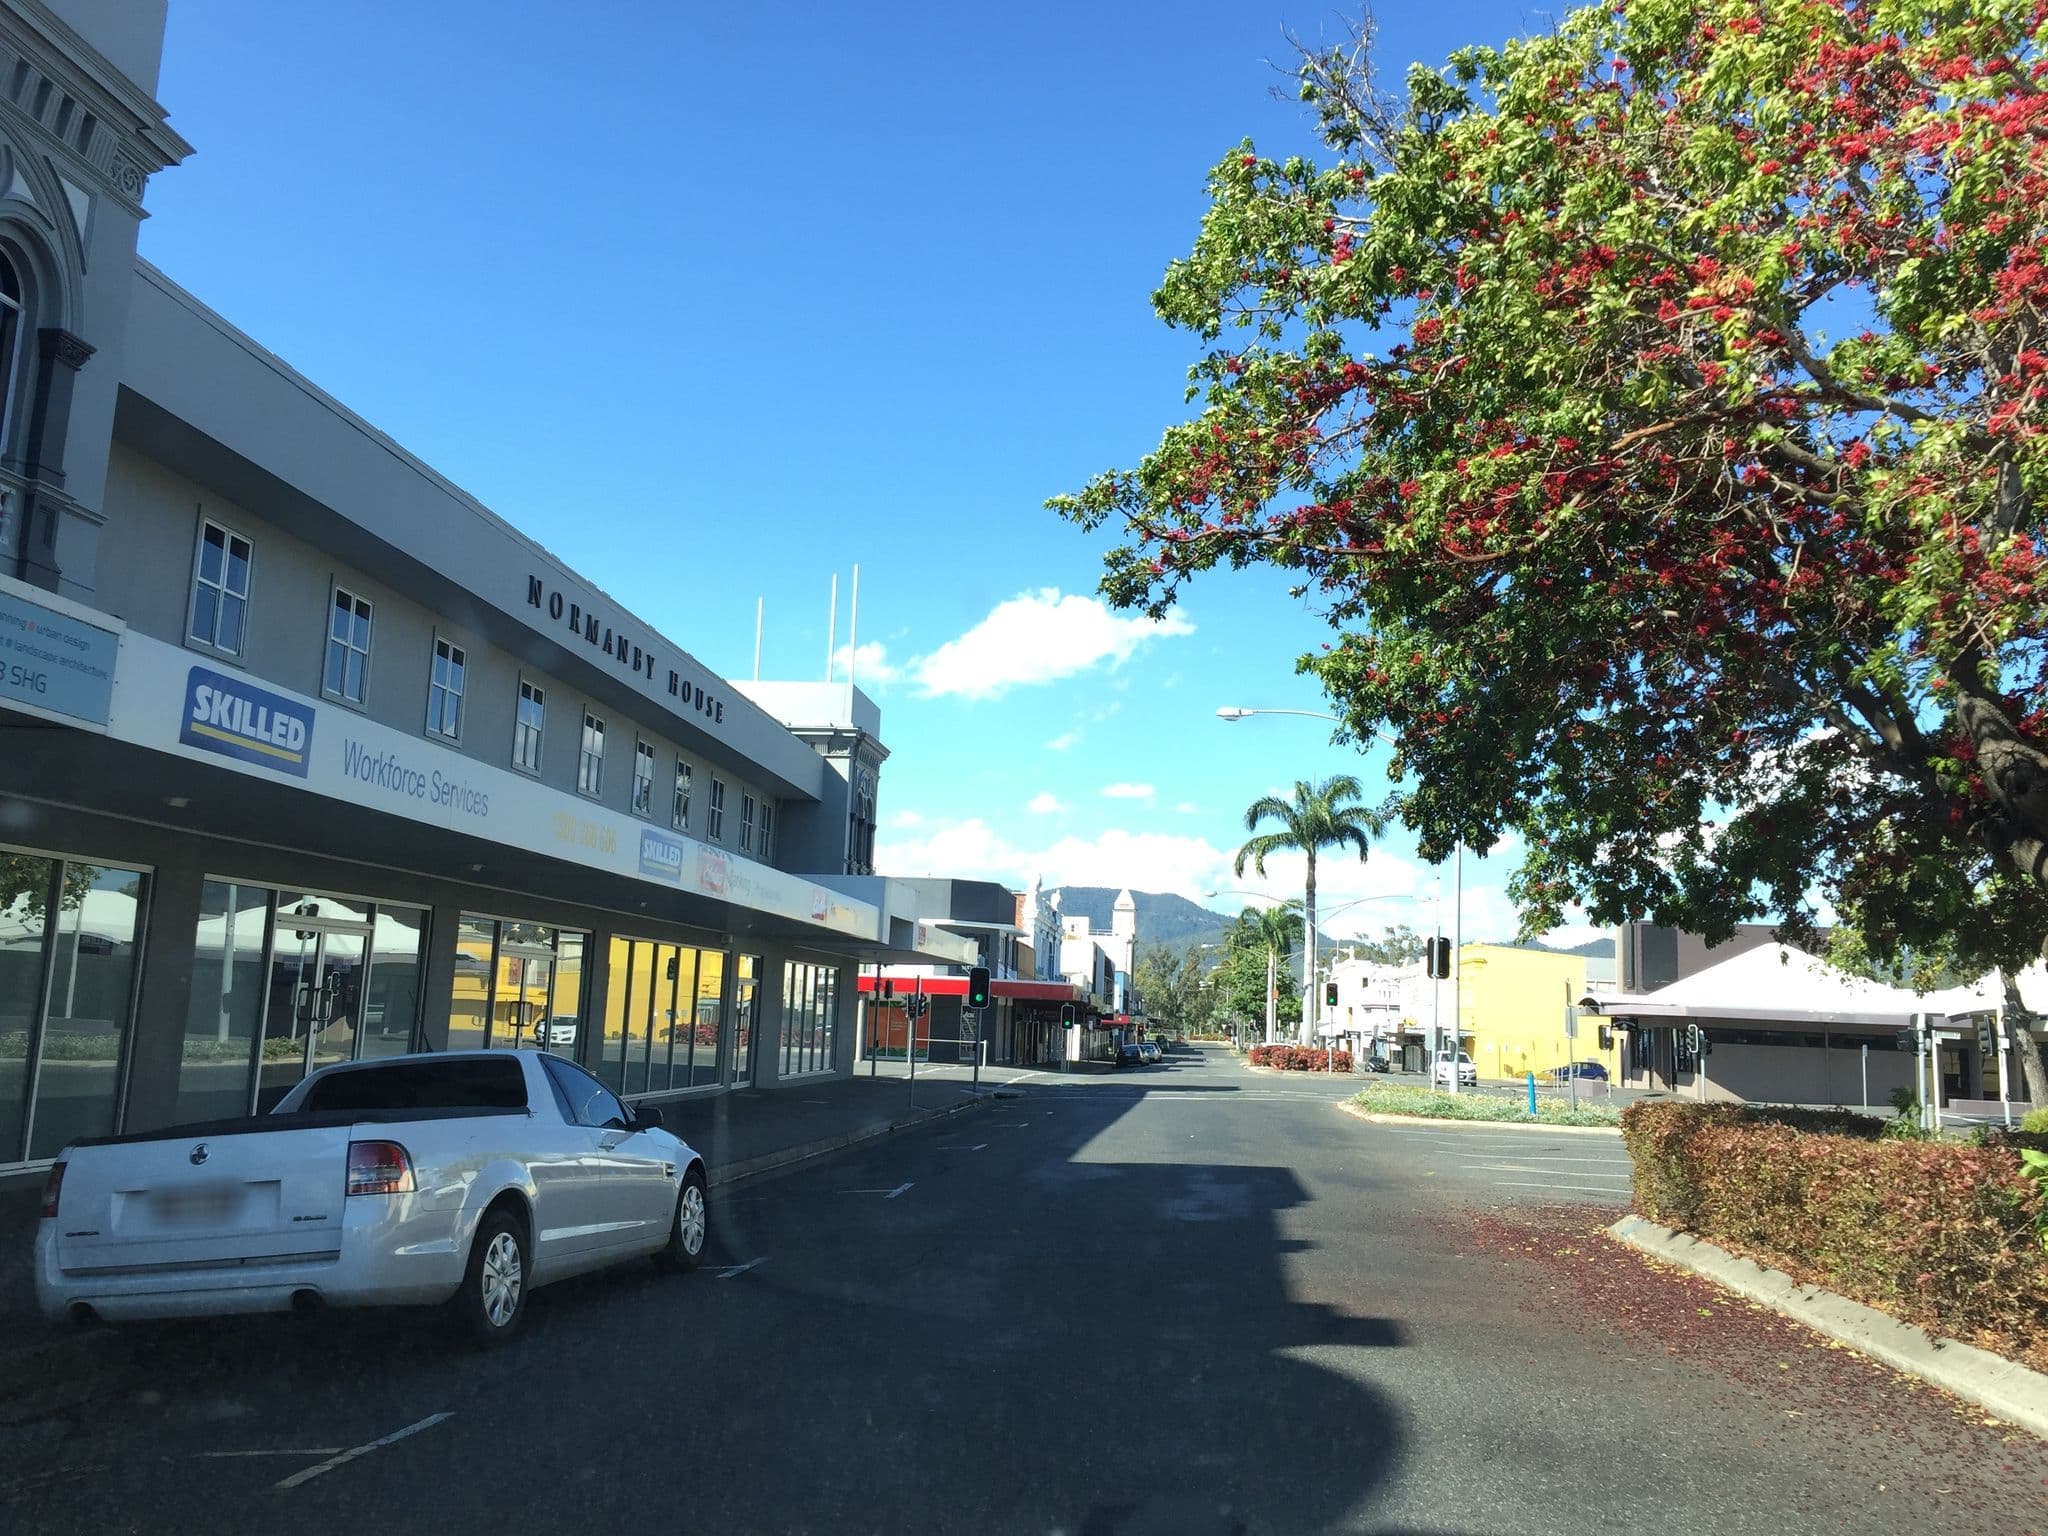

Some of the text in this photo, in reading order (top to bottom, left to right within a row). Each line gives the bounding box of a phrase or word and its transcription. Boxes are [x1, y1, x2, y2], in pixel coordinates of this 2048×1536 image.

[10, 665, 48, 694] SHG
[527, 574, 724, 724] NORMANBY HOUSE
[192, 684, 306, 751] SKILLED
[343, 738, 490, 818] Workforce Services
[642, 838, 682, 868] SKILLED
